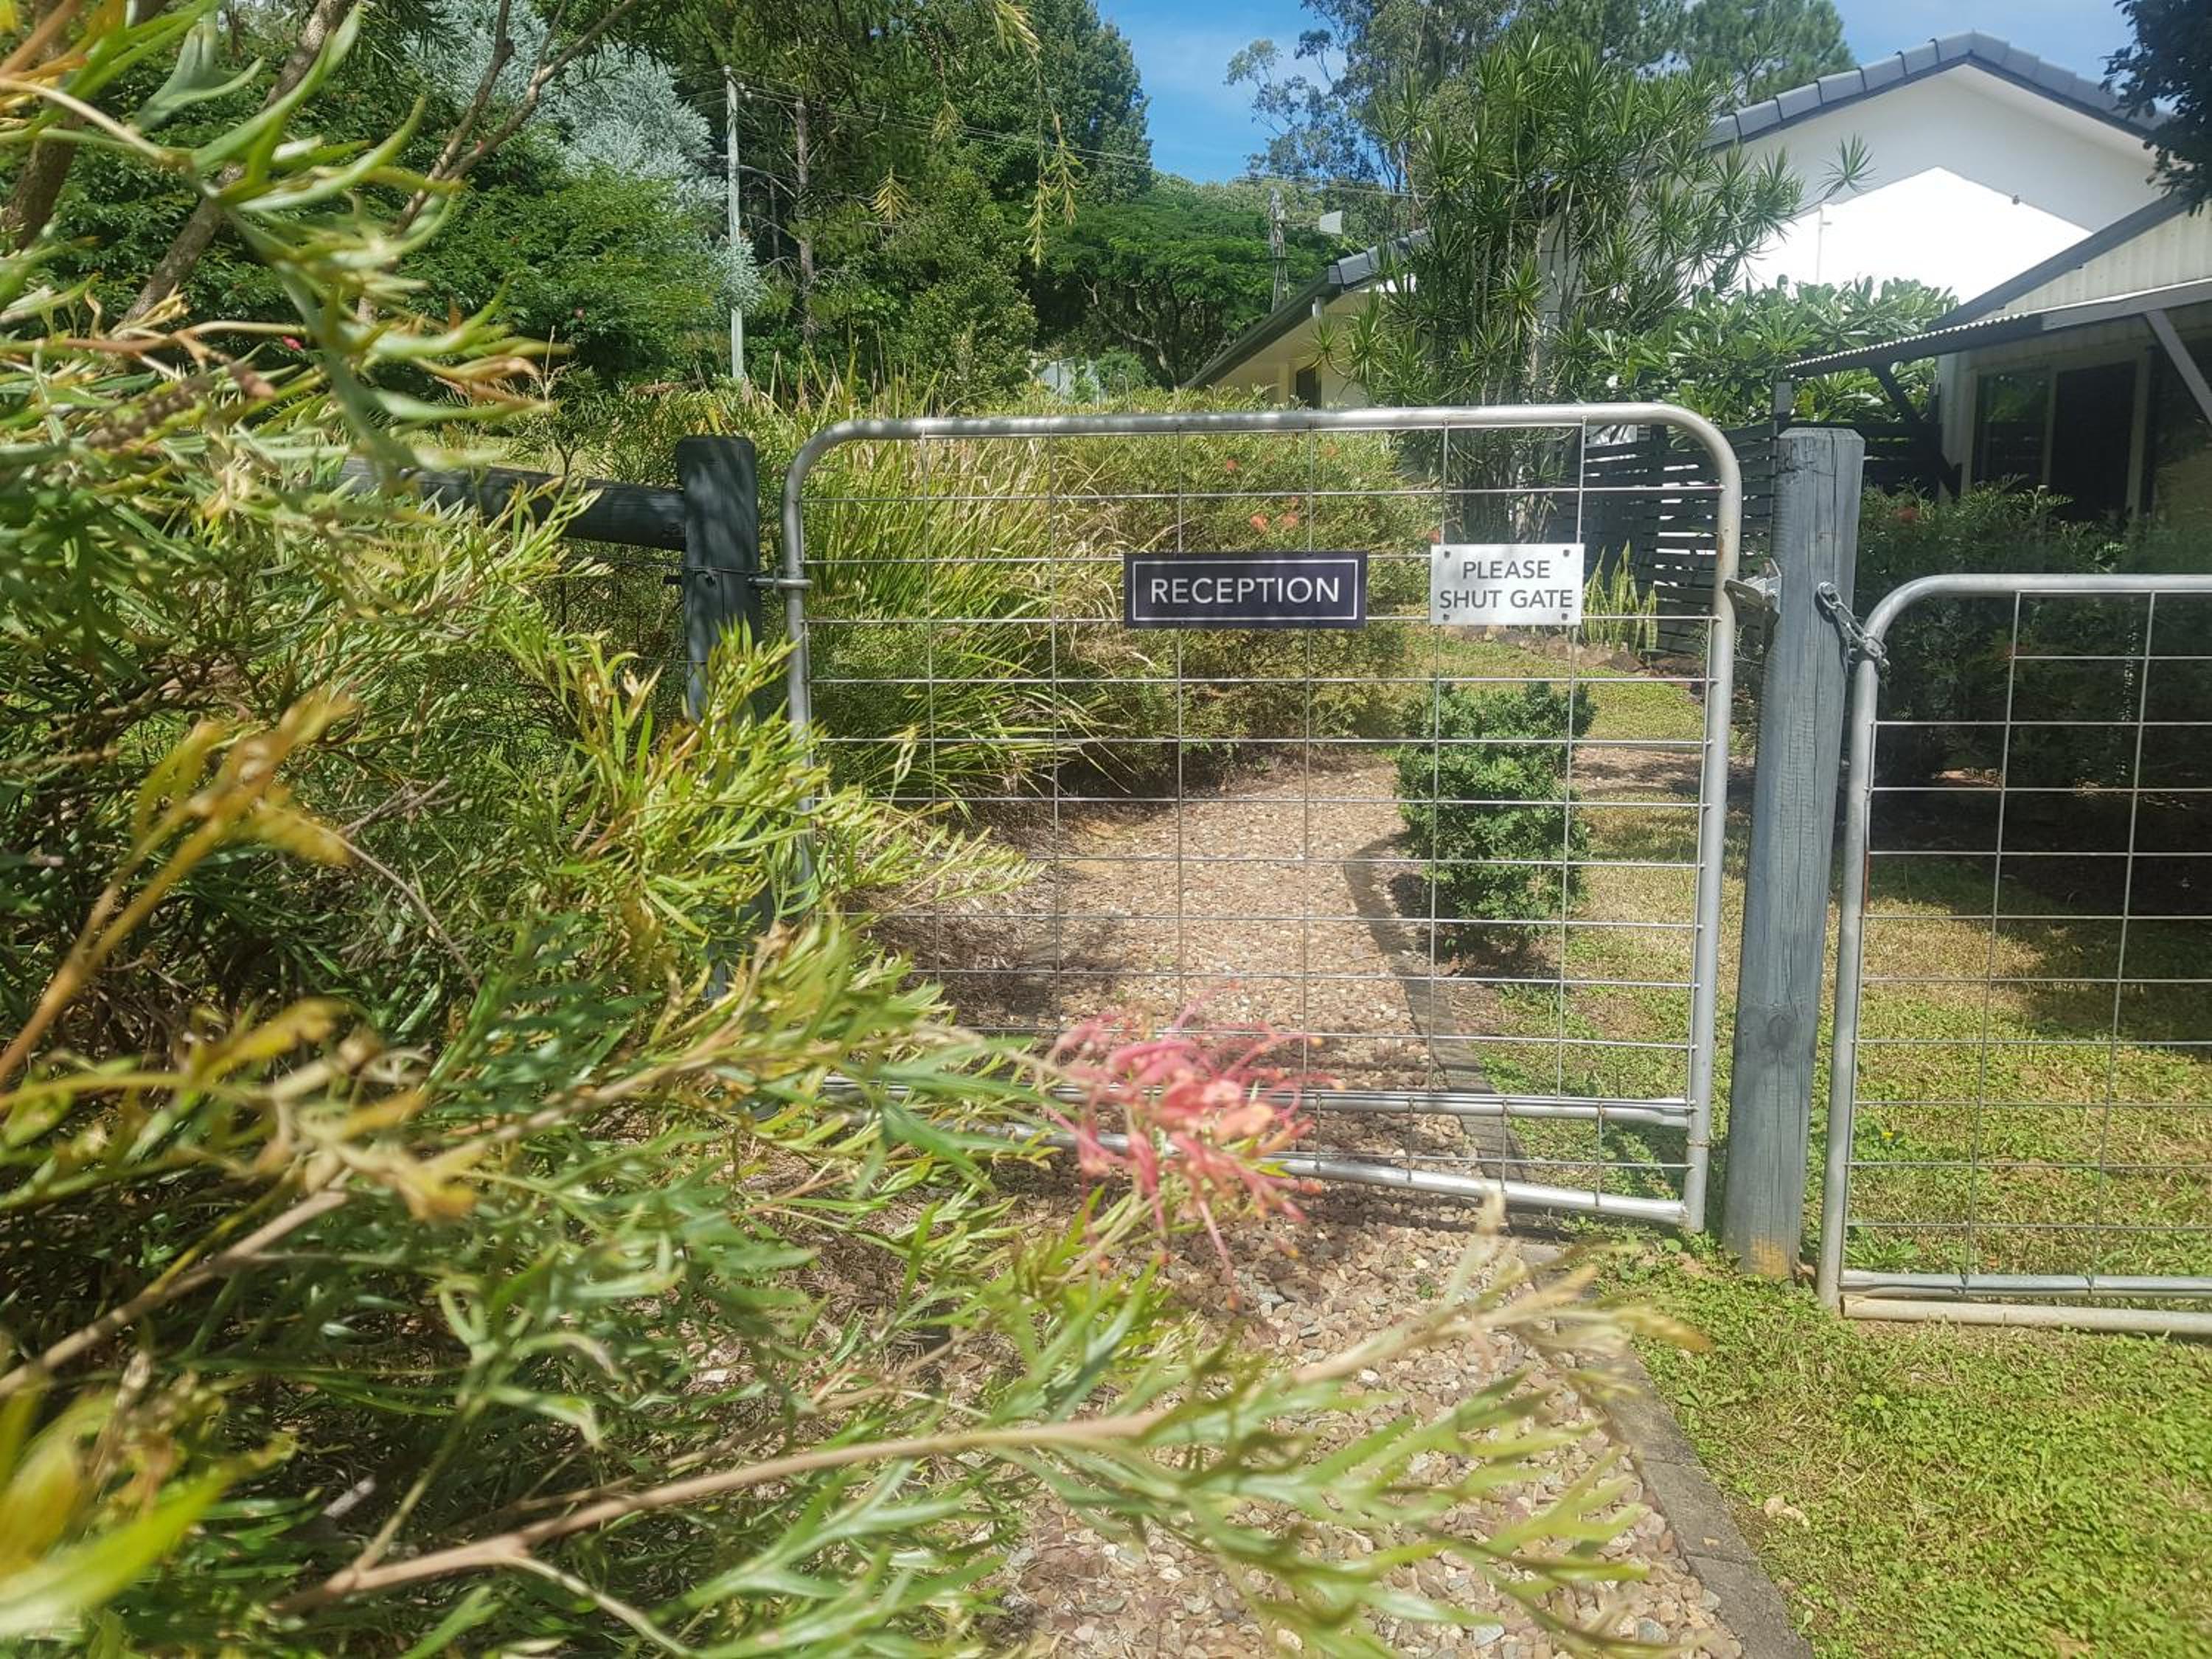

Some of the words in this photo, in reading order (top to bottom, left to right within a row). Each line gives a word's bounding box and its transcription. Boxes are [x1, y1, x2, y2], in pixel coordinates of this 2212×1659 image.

[1463, 560, 1551, 579] PLEASE
[1150, 577, 1339, 603] RECEPTION
[1439, 590, 1502, 608] SHUT
[1510, 589, 1573, 608] GATE
